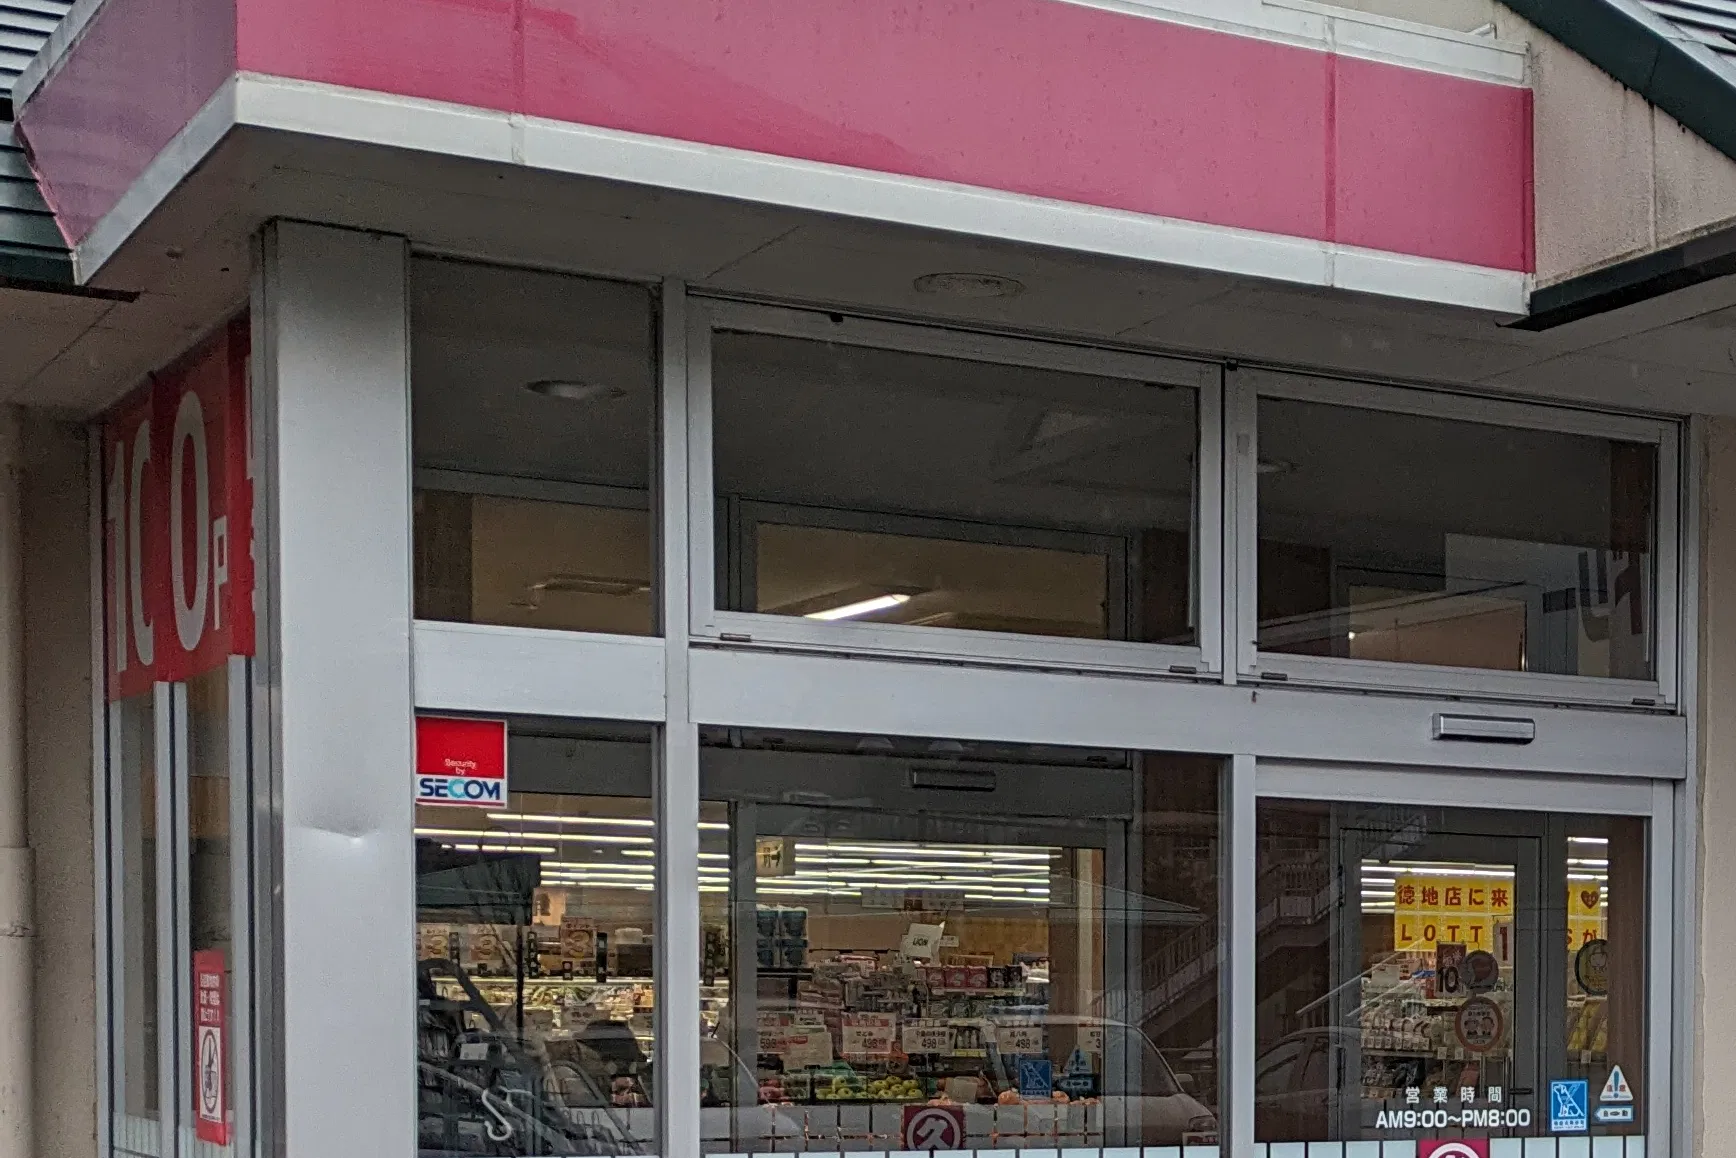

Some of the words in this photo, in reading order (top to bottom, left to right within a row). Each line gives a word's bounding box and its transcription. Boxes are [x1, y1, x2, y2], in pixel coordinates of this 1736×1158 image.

[419, 778, 501, 800] SECOM
[1397, 884, 1509, 907] 徳地店に来
[1405, 1086, 1503, 1104] 営業時間
